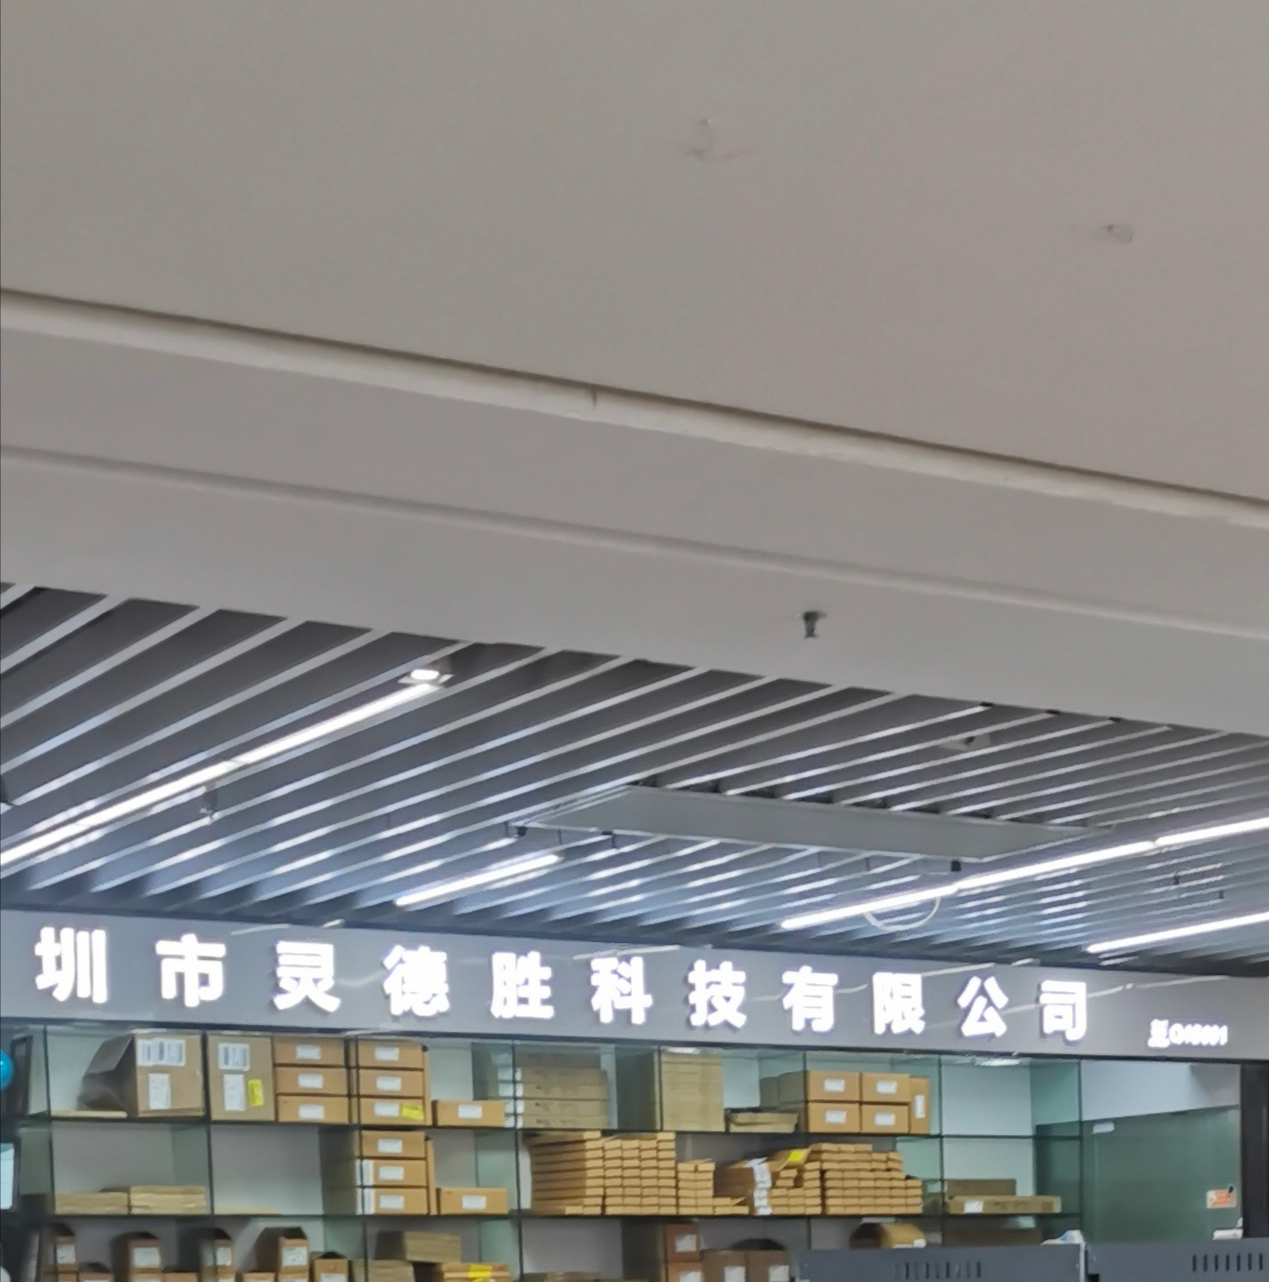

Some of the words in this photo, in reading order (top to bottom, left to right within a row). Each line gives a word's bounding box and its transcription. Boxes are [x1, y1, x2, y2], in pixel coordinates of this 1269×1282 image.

[35, 926, 1088, 1042] 圳市灵德胜科技有限公司
